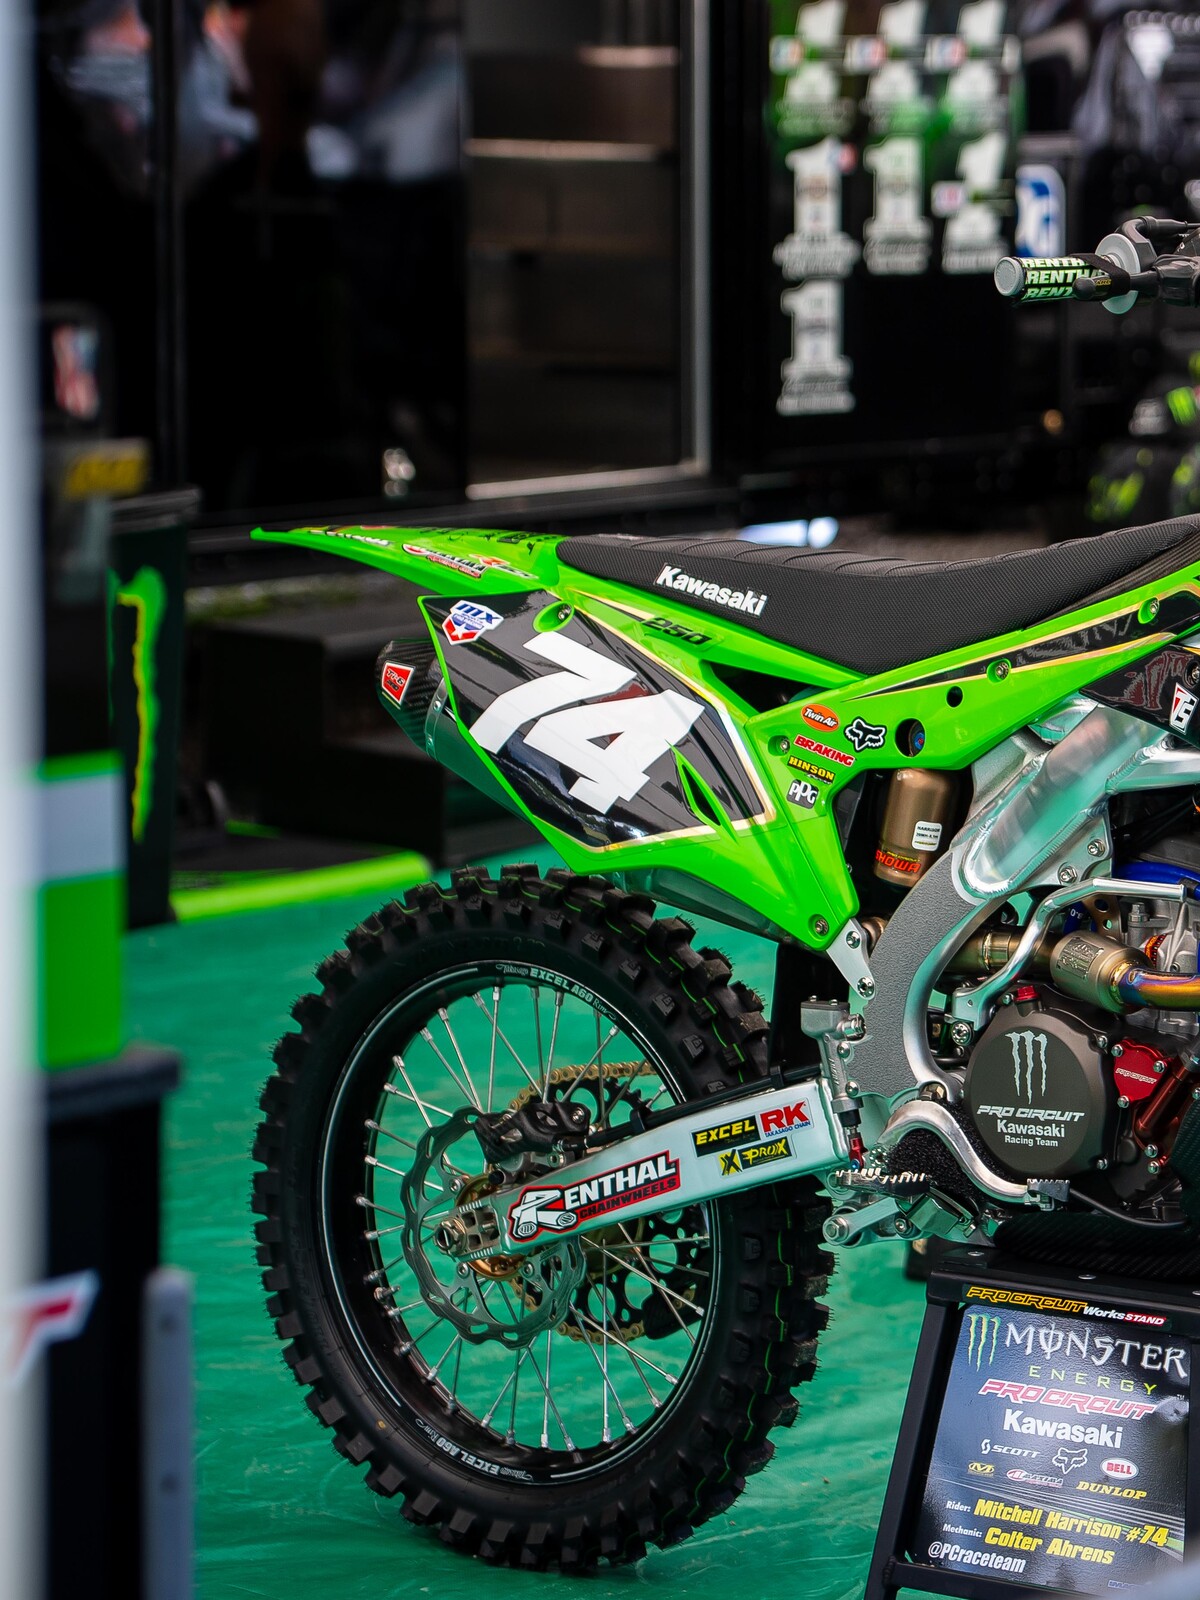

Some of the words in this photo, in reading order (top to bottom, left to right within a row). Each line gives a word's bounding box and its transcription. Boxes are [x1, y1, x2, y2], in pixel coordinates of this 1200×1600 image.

[657, 565, 767, 617] Kawasaki
[641, 617, 714, 645] 250
[468, 632, 705, 815] 74
[803, 707, 824, 723] Twin
[822, 716, 837, 728] Air
[794, 734, 855, 767] BRAKING
[788, 756, 835, 781] HINSON
[875, 849, 922, 873] SHOWA
[529, 967, 570, 990] EXCEL
[570, 984, 594, 1003] A60
[760, 1100, 810, 1133] RK
[765, 1126, 794, 1138] TAKASAGO
[793, 1120, 811, 1130] CHAIN
[976, 1104, 1014, 1118] PRO
[1015, 1108, 1085, 1122] CIRCUIT
[997, 1119, 1065, 1138] Kawasaki
[695, 1119, 756, 1146] EXCEL
[1004, 1134, 1034, 1148] Racing
[1035, 1137, 1058, 1147] Team
[511, 1157, 678, 1240] RENTHAL
[579, 1177, 678, 1219] CHAINWHEELS
[966, 1285, 1011, 1303] PRO
[1008, 1292, 1089, 1313] CIRCUIT
[1005, 1322, 1188, 1379] MONSTER
[1028, 1364, 1158, 1396] ENERGY
[978, 1378, 1044, 1405] PRO
[1040, 1388, 1158, 1421] CIRCUIT
[1003, 1408, 1123, 1449] Kawasaki
[991, 1443, 1042, 1459] SCOTT
[1106, 1462, 1133, 1475] BELL
[1075, 1481, 1148, 1500] DUNLOP
[945, 1500, 972, 1513] Rider:
[973, 1499, 1044, 1526] Mitchell
[1045, 1511, 1122, 1540] Harrison
[1124, 1524, 1169, 1548] #74
[927, 1541, 1027, 1574] @PCraceteam
[942, 1523, 983, 1539] Mechanic:
[984, 1527, 1044, 1553] Colter
[1045, 1537, 1116, 1566] Ahrens
